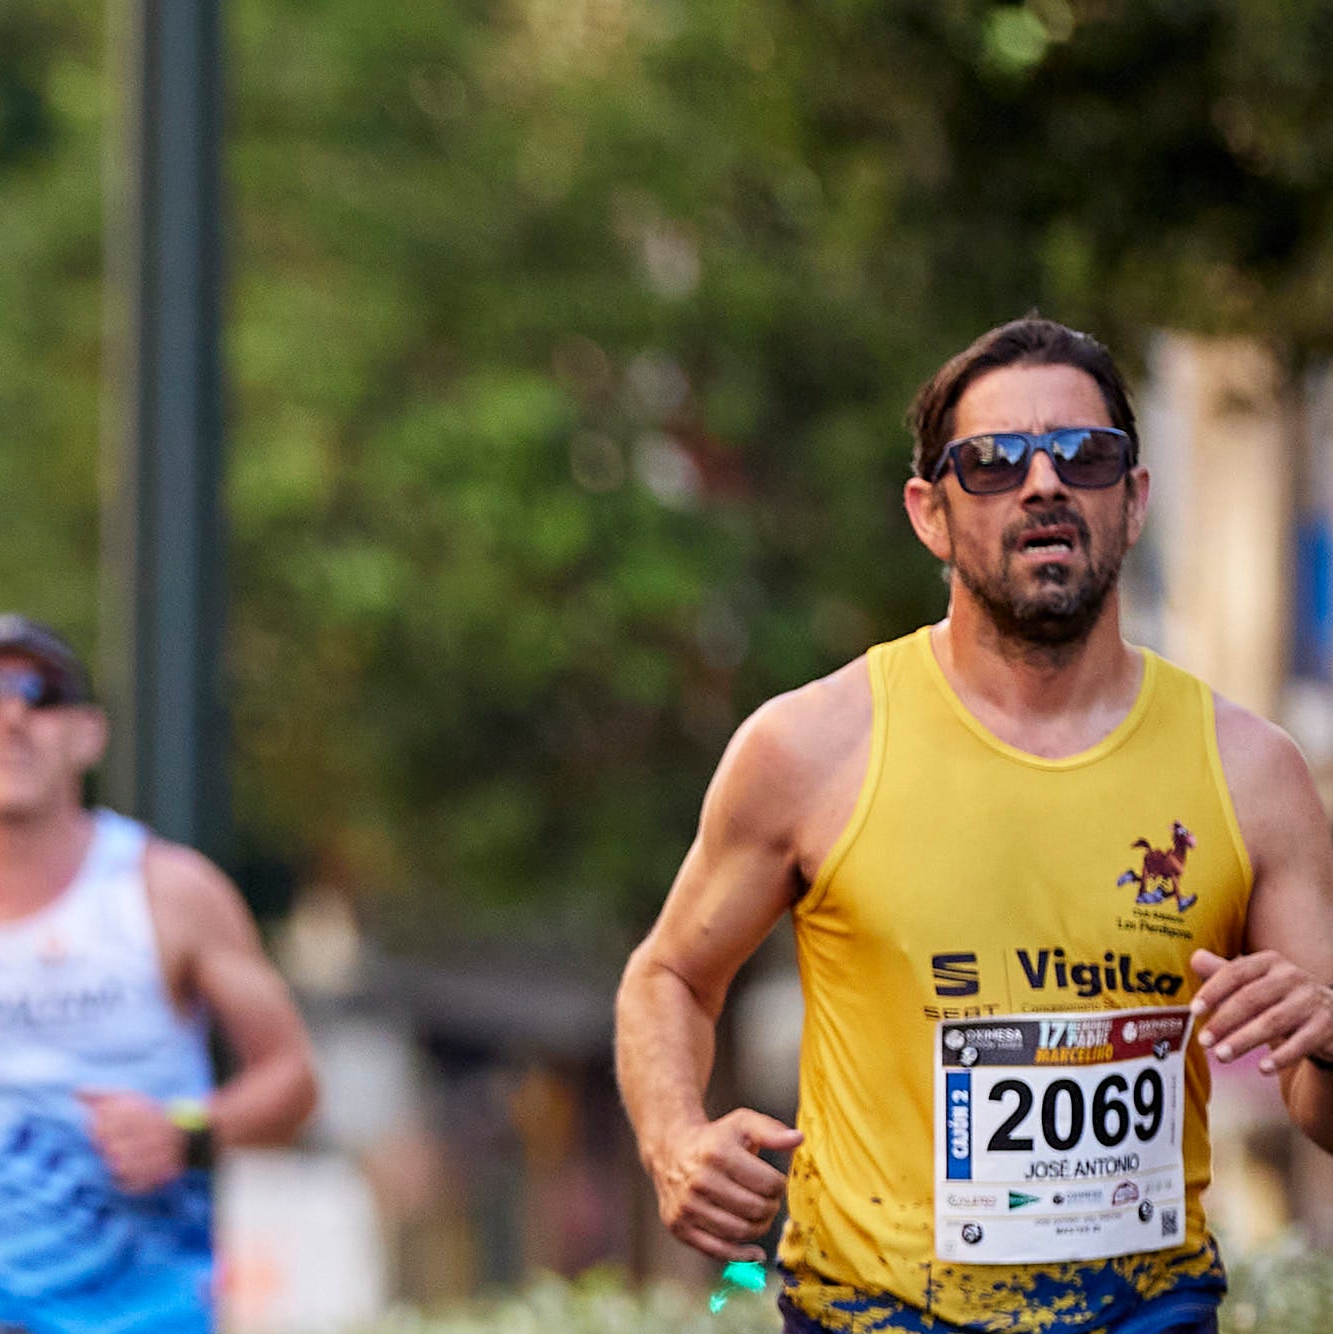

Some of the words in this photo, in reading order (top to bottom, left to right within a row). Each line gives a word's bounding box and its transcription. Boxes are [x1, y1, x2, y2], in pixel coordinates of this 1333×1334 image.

[1016, 947, 1182, 997] Vigilsa
[1038, 1021, 1068, 1049] 17
[1035, 1043, 1114, 1064] MARCELINO
[987, 1068, 1163, 1151] 2069
[1075, 1153, 1140, 1177] ANTONIO
